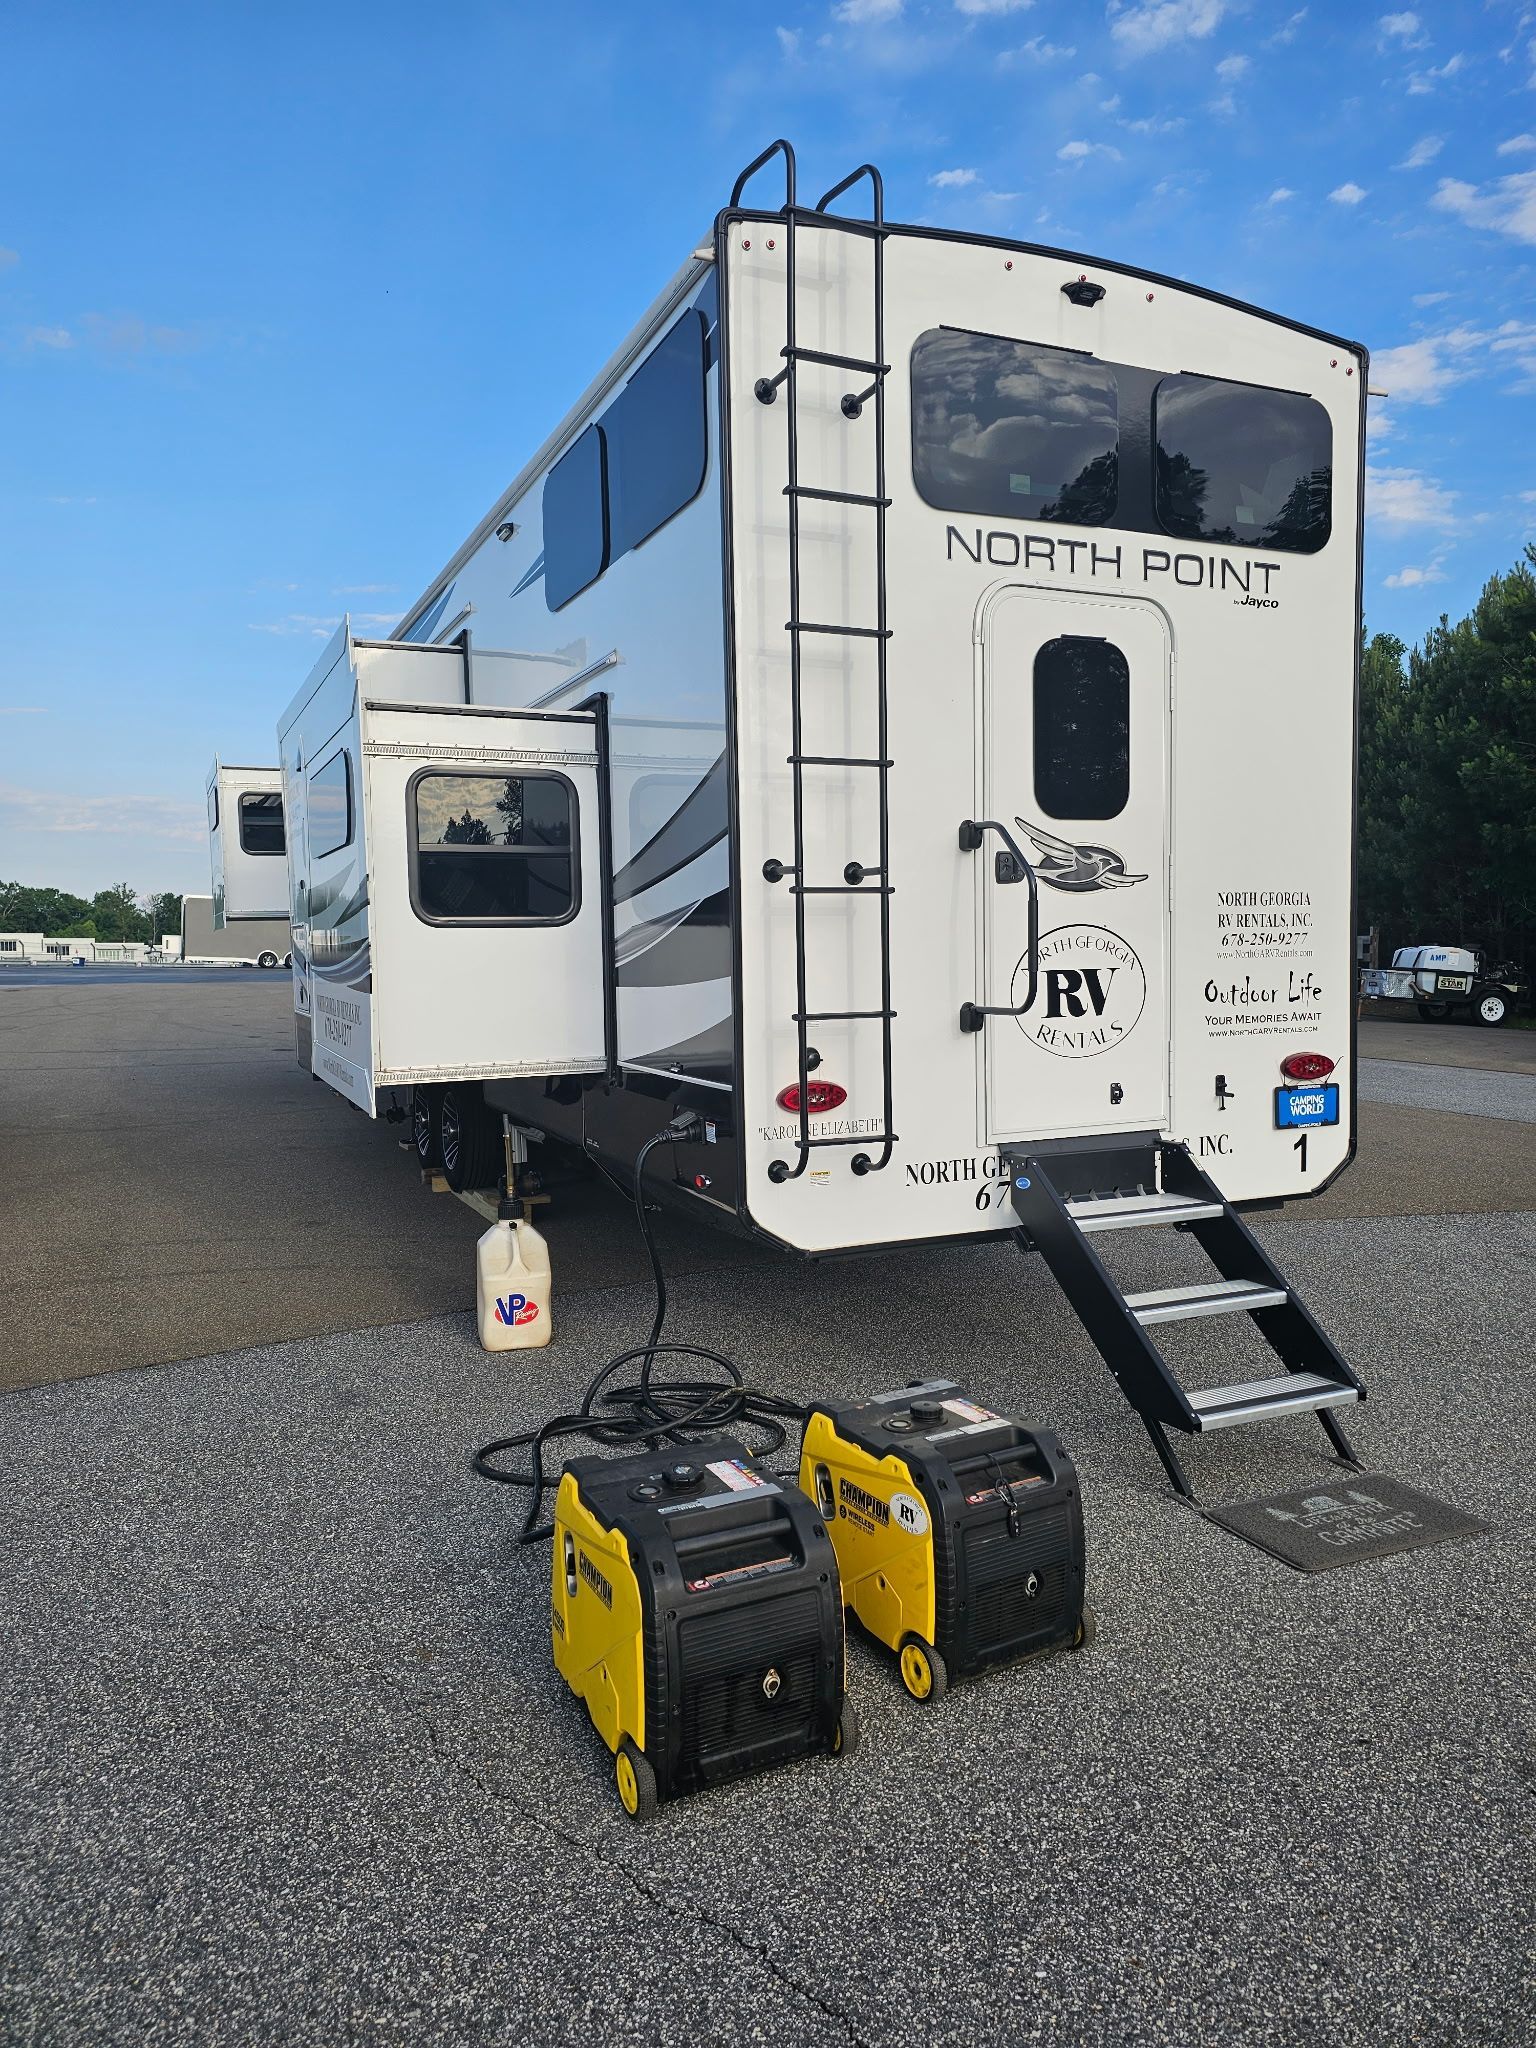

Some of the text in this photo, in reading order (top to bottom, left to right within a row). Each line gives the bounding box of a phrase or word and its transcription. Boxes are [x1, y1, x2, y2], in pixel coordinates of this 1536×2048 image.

[946, 524, 1281, 595] NORTH POINT
[1240, 594, 1279, 609] Jayco
[1217, 891, 1311, 907] NORTH GEORGIA
[1217, 913, 1313, 930] RV RENTALS, INC.
[1221, 932, 1308, 946] 678-250-9277
[1075, 935, 1136, 971] GEORGIA
[1216, 948, 1313, 959] www.NorthGARVRentals.com
[1040, 967, 1120, 1019] RV
[1204, 970, 1322, 1007] Outdoor Life
[1441, 979, 1463, 988] STAR
[1205, 1012, 1322, 1026] YOUR MEMORIES AWAIT
[1037, 1020, 1123, 1049] RENTALS
[1289, 1094, 1325, 1106] CAMPING
[1290, 1103, 1325, 1117] WORLD
[758, 1118, 883, 1141] "KAROLNE ELIZABETH"
[905, 1157, 976, 1187] NORTH
[1199, 1133, 1233, 1157] INC.
[1293, 1133, 1308, 1173] 1
[495, 1293, 526, 1326] VP
[840, 1478, 890, 1520] CHAMPION
[847, 1508, 875, 1532] WIRELESS
[900, 1502, 918, 1525] RV
[1317, 1514, 1424, 1546] CAMPSITE
